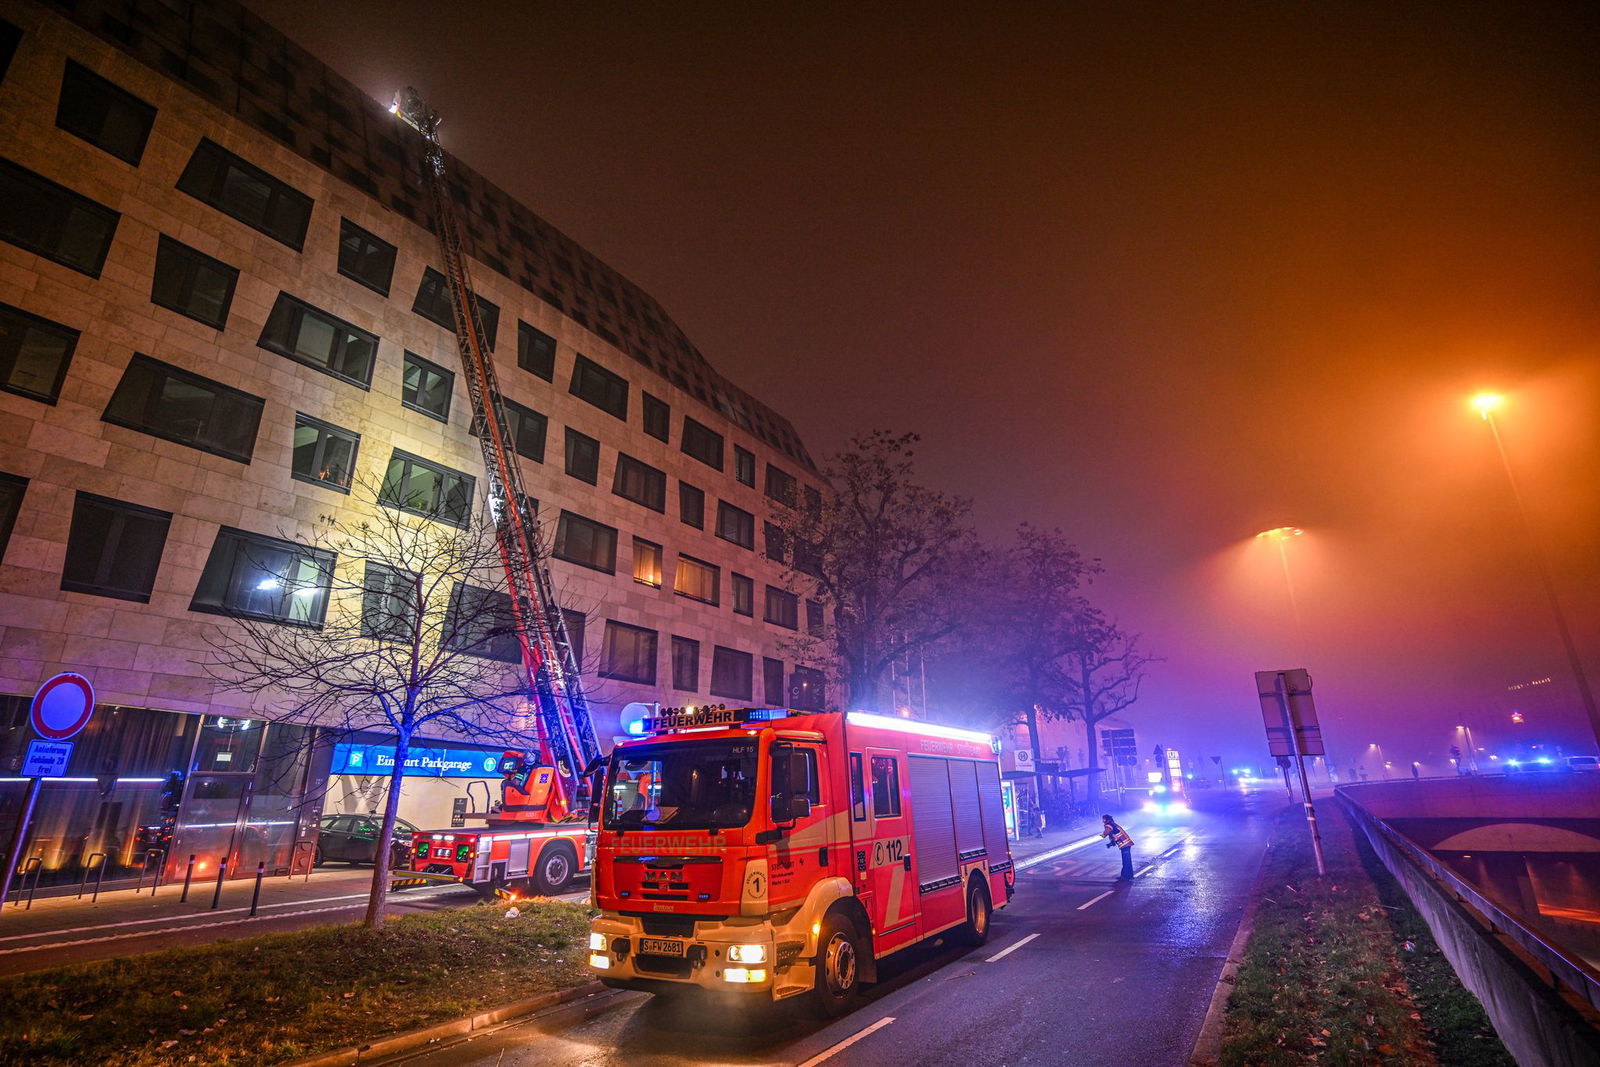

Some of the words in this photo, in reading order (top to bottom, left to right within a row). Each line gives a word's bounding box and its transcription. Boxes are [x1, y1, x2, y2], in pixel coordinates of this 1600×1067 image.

[653, 711, 732, 728] FEUERWEHR
[919, 739, 953, 753] FEUERWEHR
[38, 765, 52, 774] frei
[376, 754, 420, 767] Einhrt
[421, 757, 472, 771] Parkgarage
[611, 835, 727, 854] FEUERWEHR
[886, 839, 903, 862] 112
[644, 871, 683, 881] MAN
[753, 877, 760, 893] 1
[643, 941, 649, 951] S
[652, 943, 662, 951] FW
[663, 943, 681, 953] 2681
